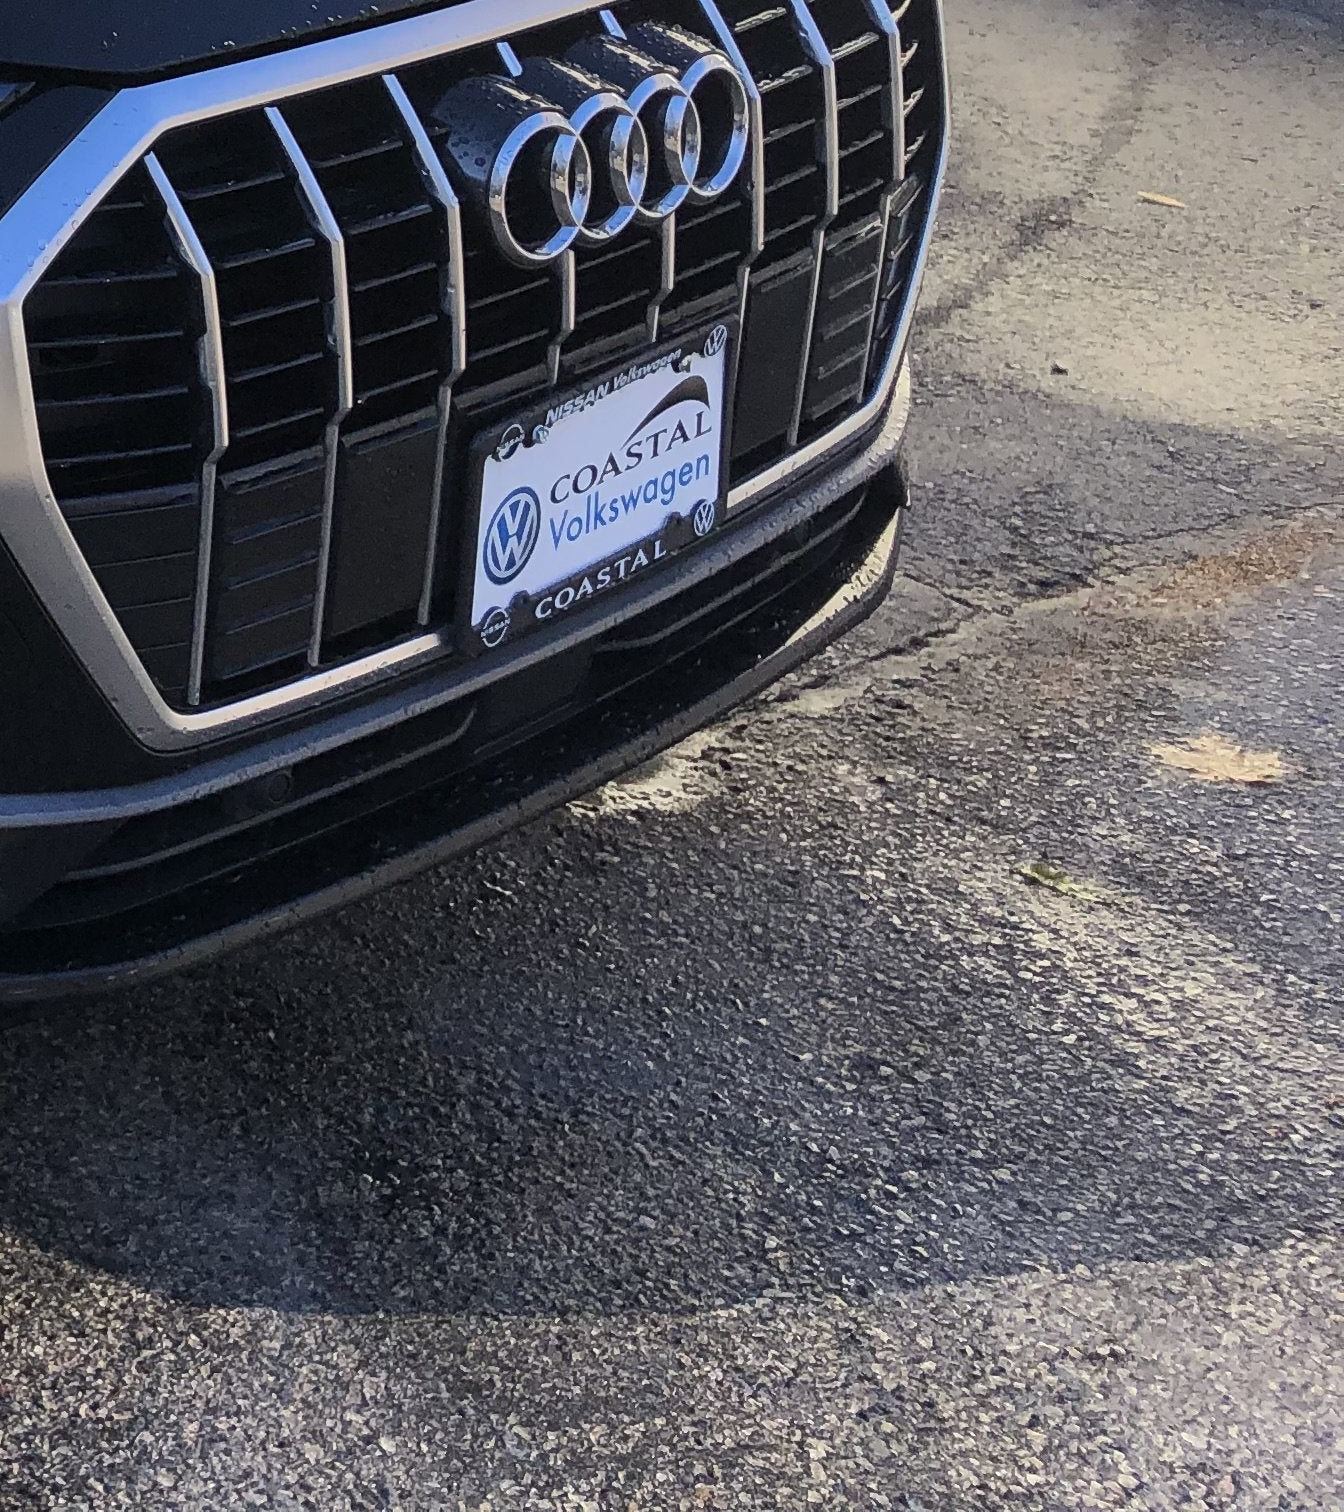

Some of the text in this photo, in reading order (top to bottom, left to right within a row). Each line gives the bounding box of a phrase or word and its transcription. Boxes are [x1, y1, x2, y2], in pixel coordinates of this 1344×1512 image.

[549, 410, 712, 505] COASTAL
[549, 453, 710, 551] Volkswagen
[534, 539, 667, 619] COASTAL
